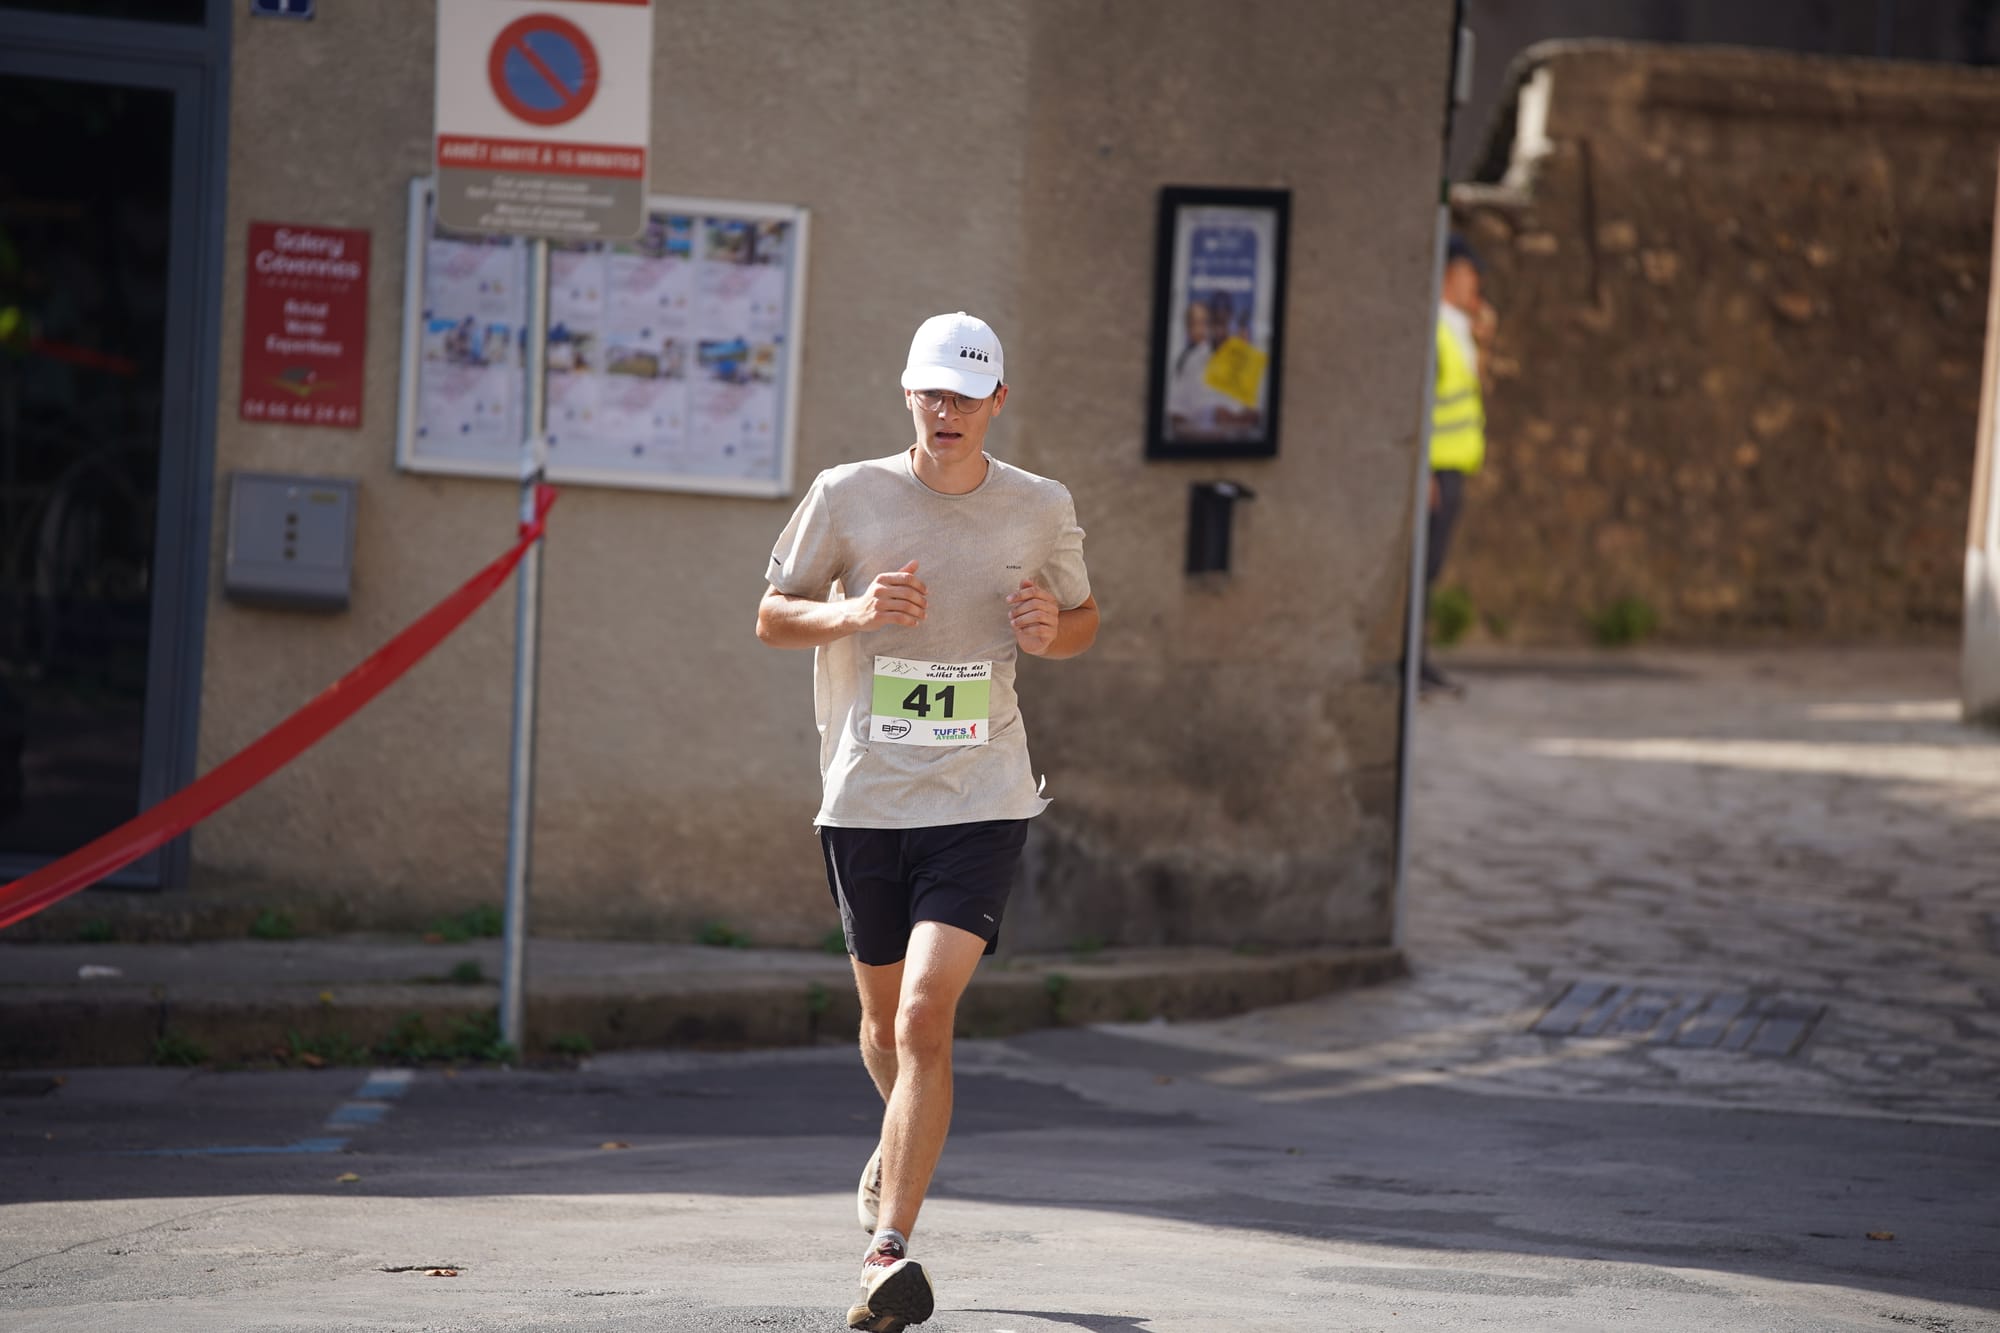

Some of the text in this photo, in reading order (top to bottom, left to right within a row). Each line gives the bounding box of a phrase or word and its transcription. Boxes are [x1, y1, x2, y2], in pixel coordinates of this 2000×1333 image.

[930, 664, 967, 673] Challenge
[902, 684, 955, 718] 41
[881, 724, 907, 733] BFP
[932, 727, 966, 736] TUFF'S
